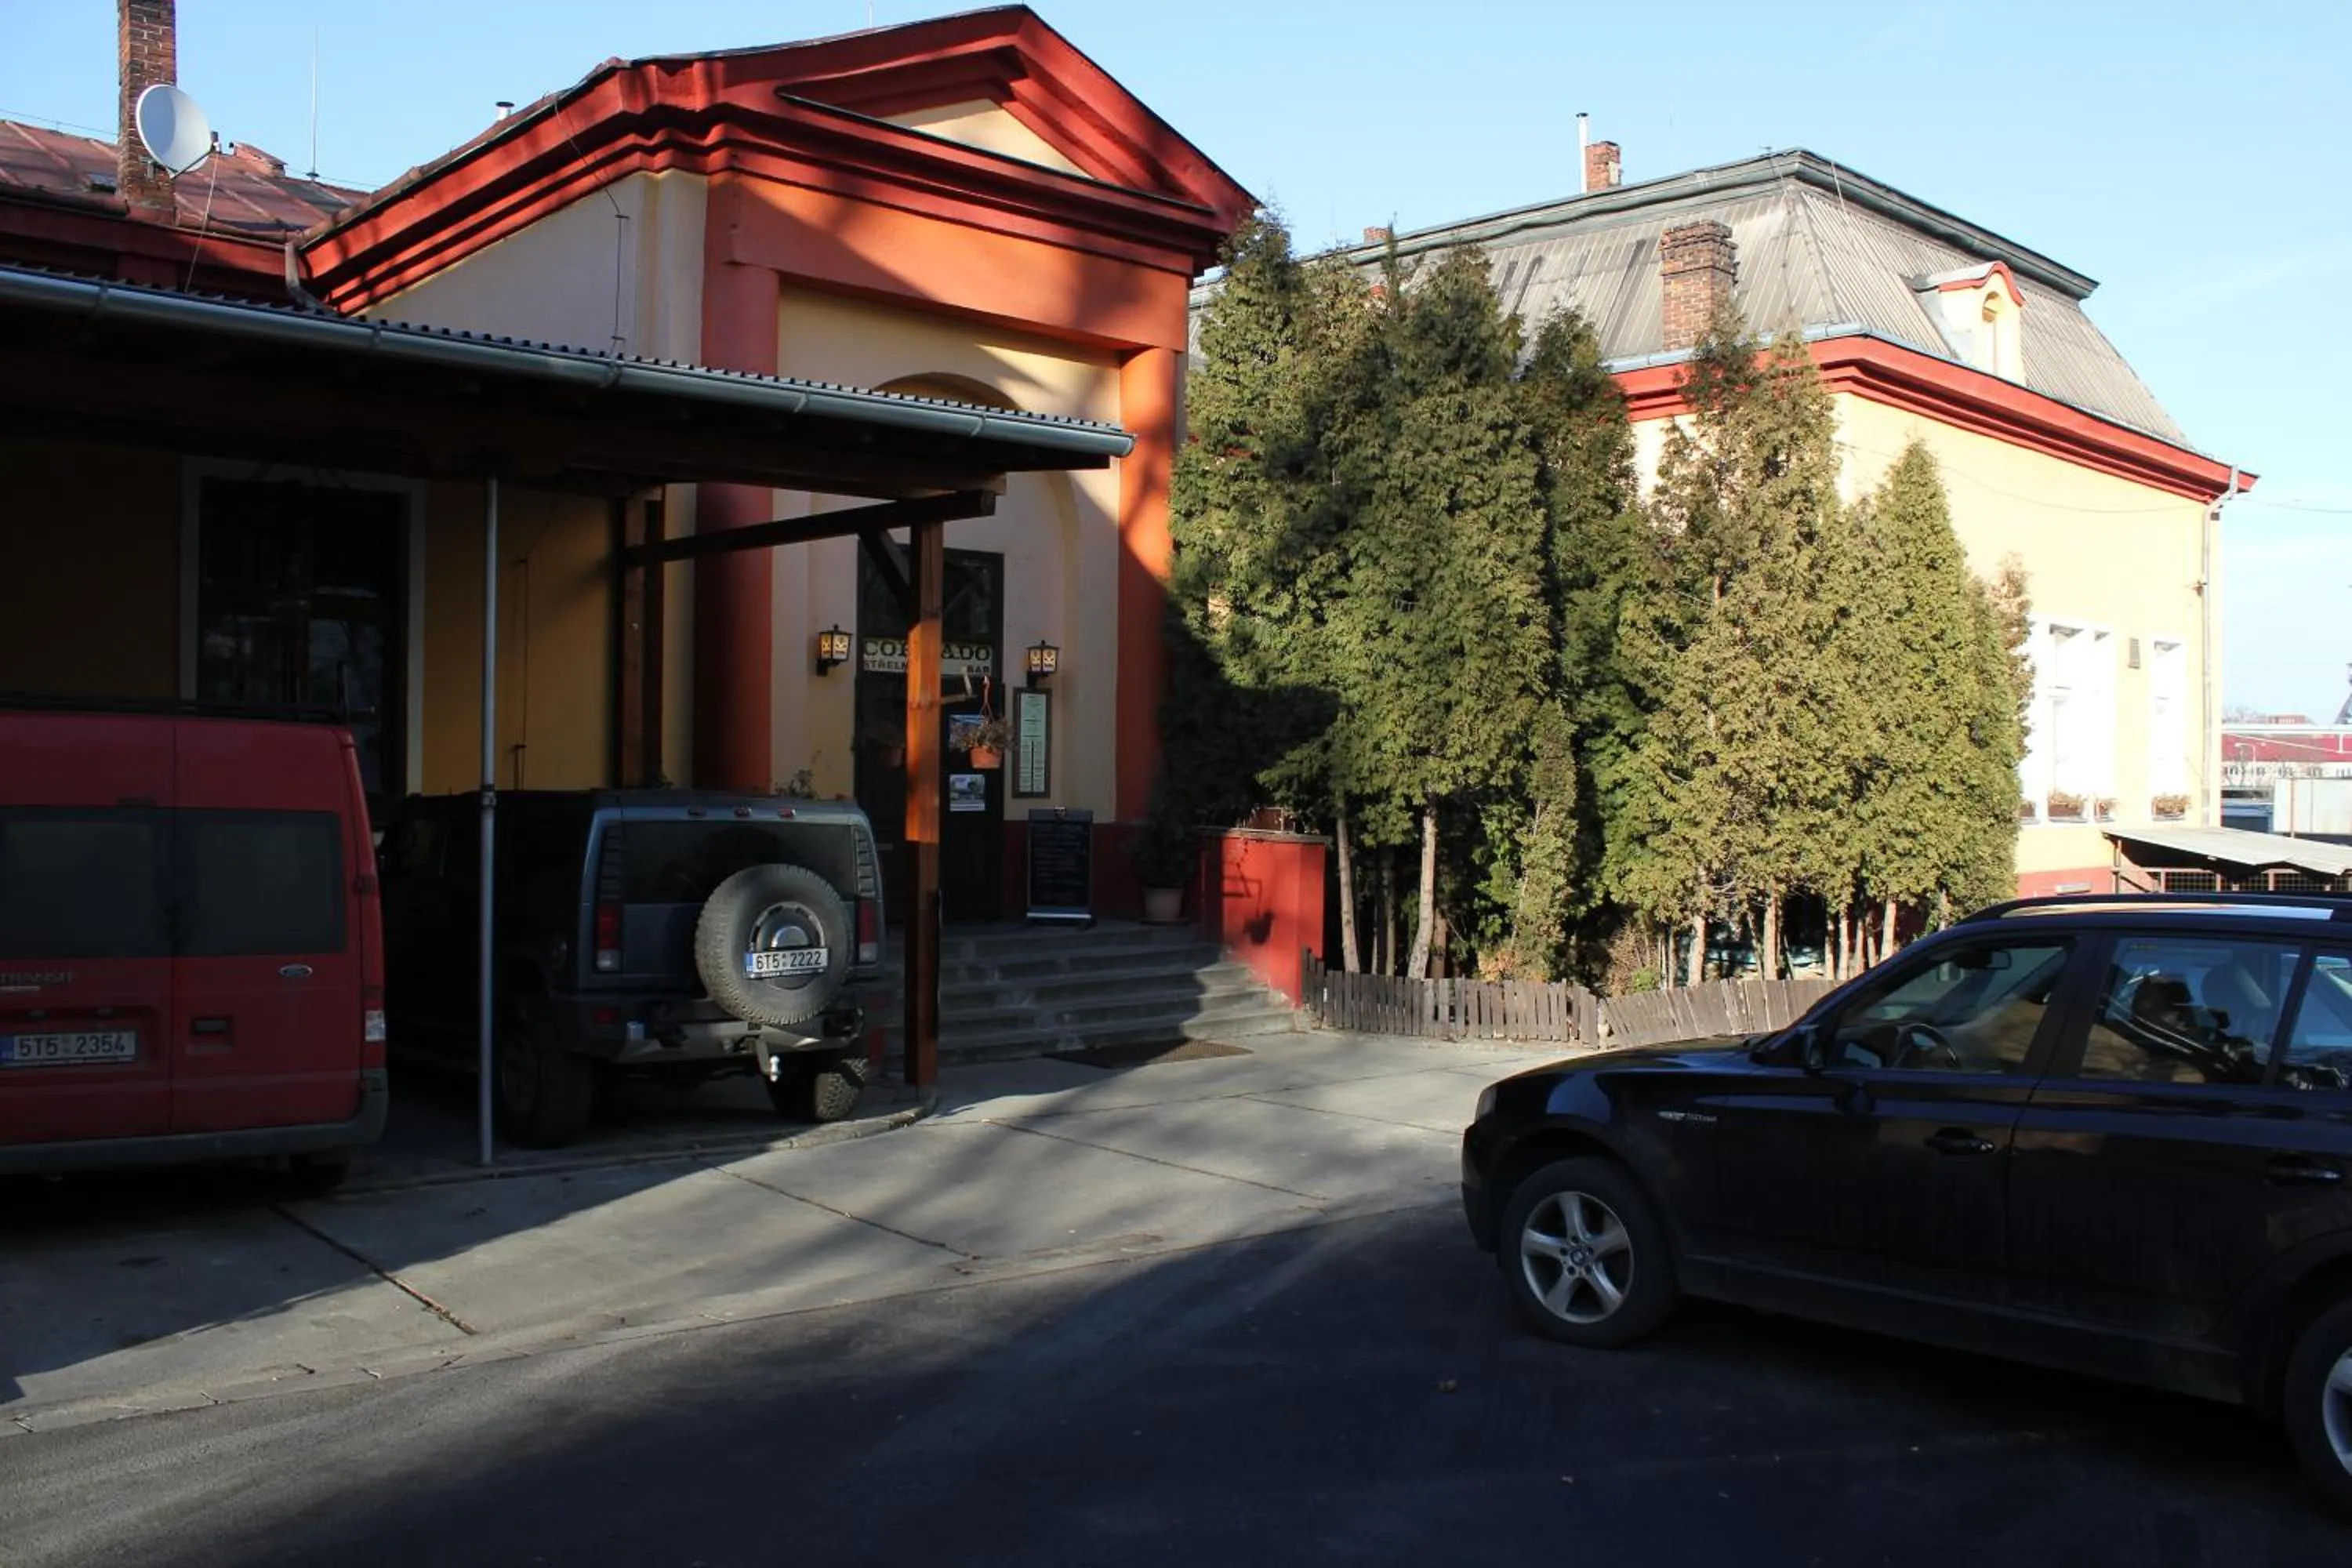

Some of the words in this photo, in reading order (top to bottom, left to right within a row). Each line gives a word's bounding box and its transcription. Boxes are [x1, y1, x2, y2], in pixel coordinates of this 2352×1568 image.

[756, 953, 779, 969] 6T5
[789, 951, 821, 967] 2222
[19, 1036, 58, 1056] 5T5
[74, 1035, 125, 1055] 2354
